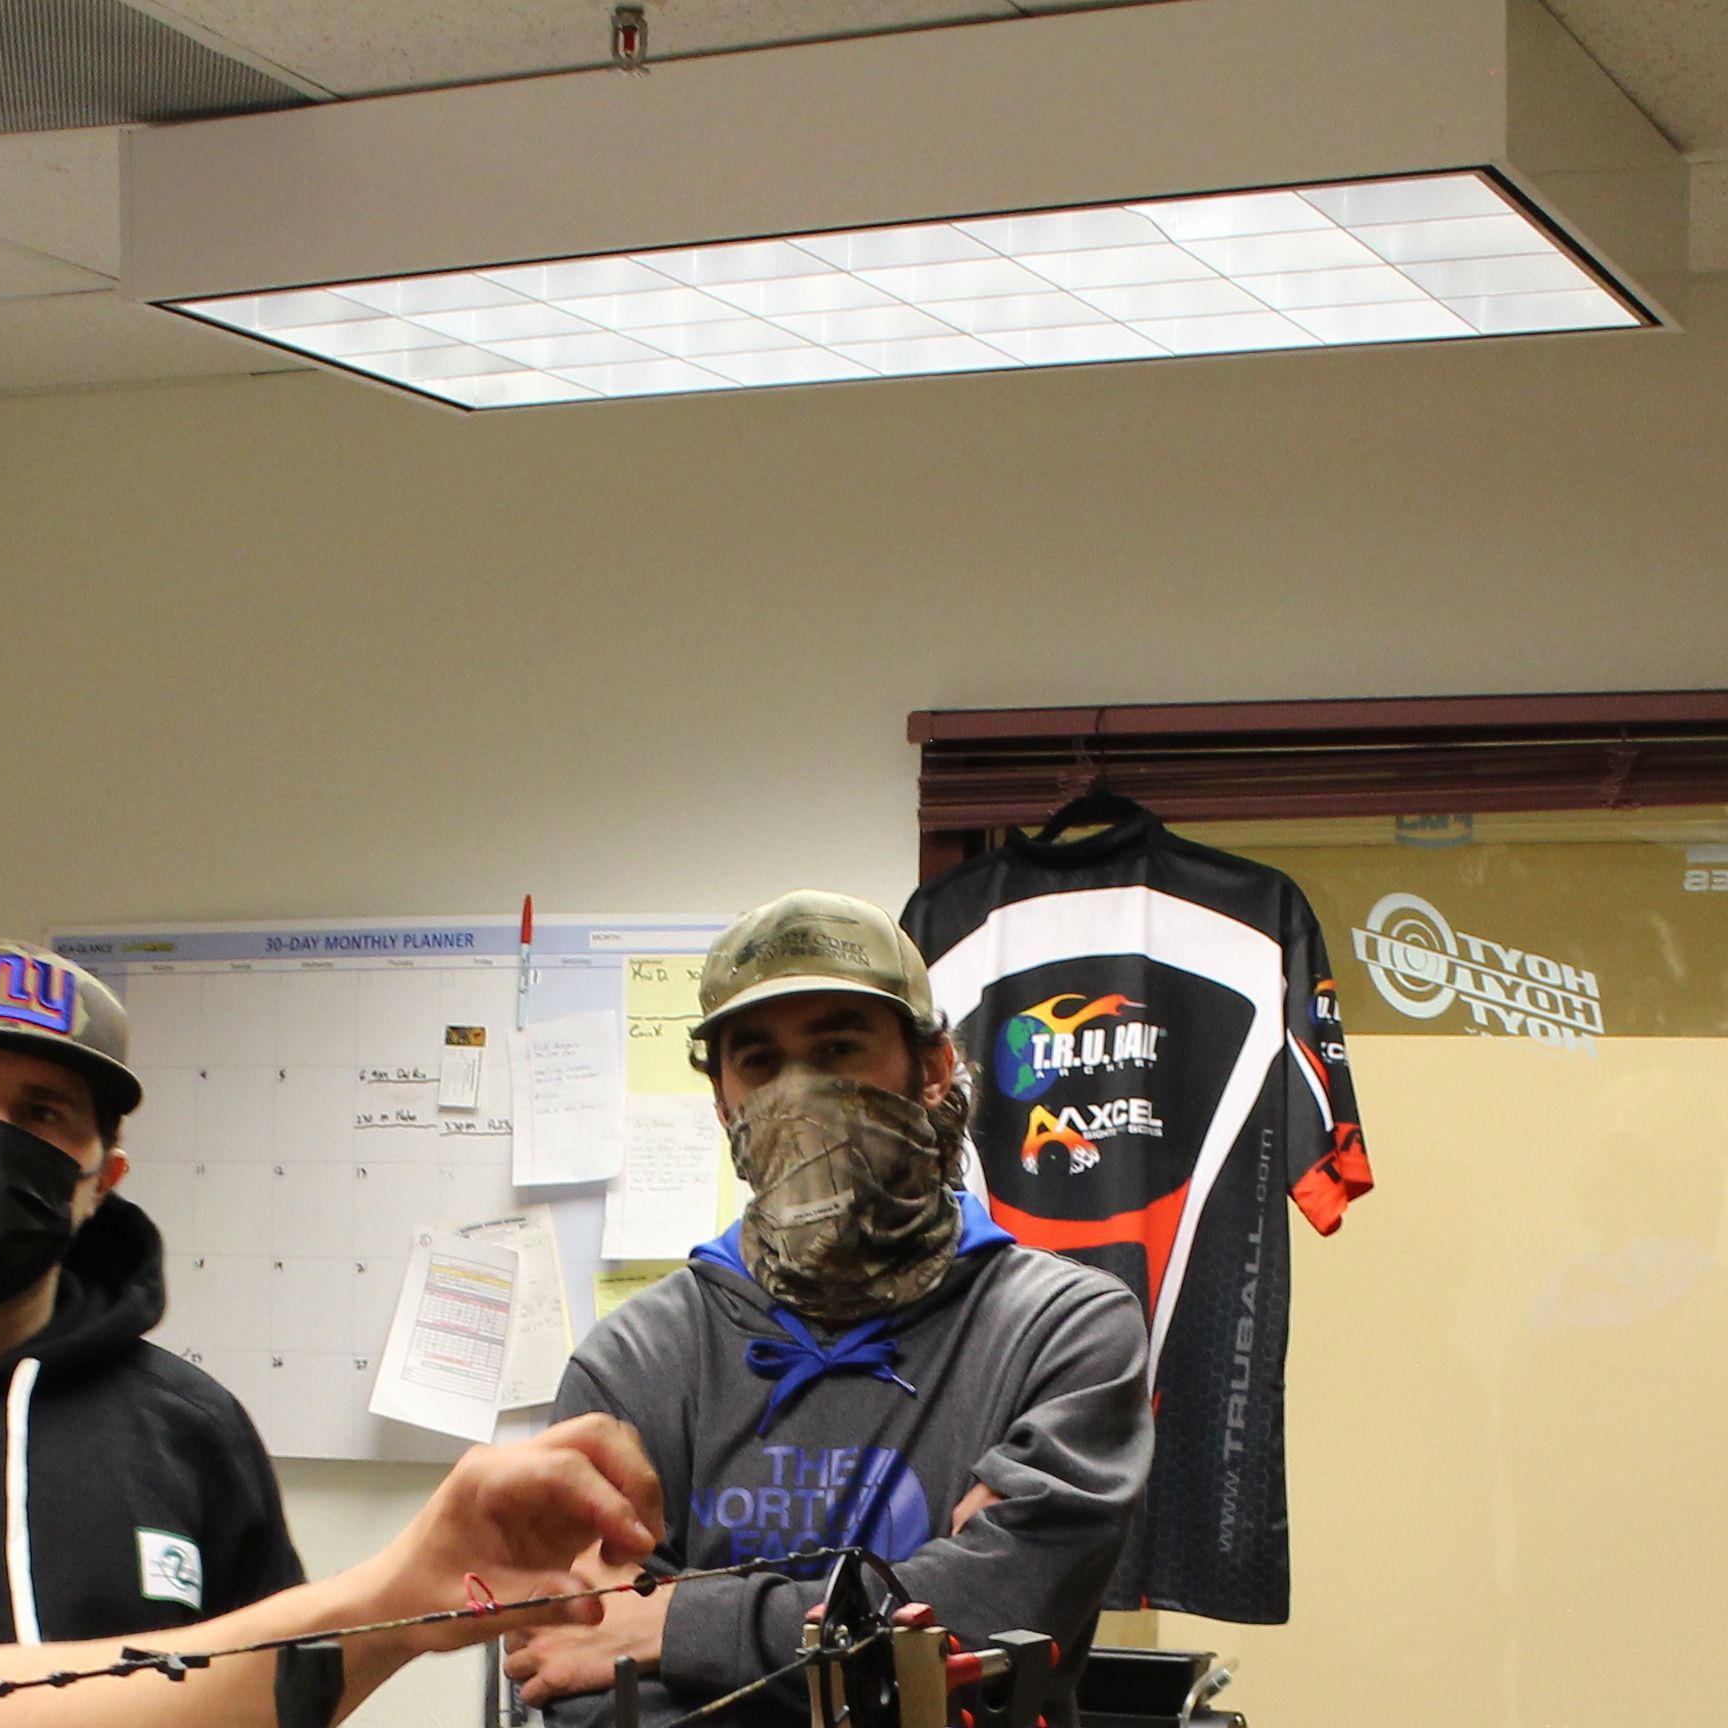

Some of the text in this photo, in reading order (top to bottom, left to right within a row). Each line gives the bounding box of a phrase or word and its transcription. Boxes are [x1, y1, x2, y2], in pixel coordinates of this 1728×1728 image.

[264, 932, 475, 953] 30-DAY MONTHLY PLANNER
[1219, 1128, 1274, 1553] www.TRUBALL.com
[762, 1445, 860, 1487] THE
